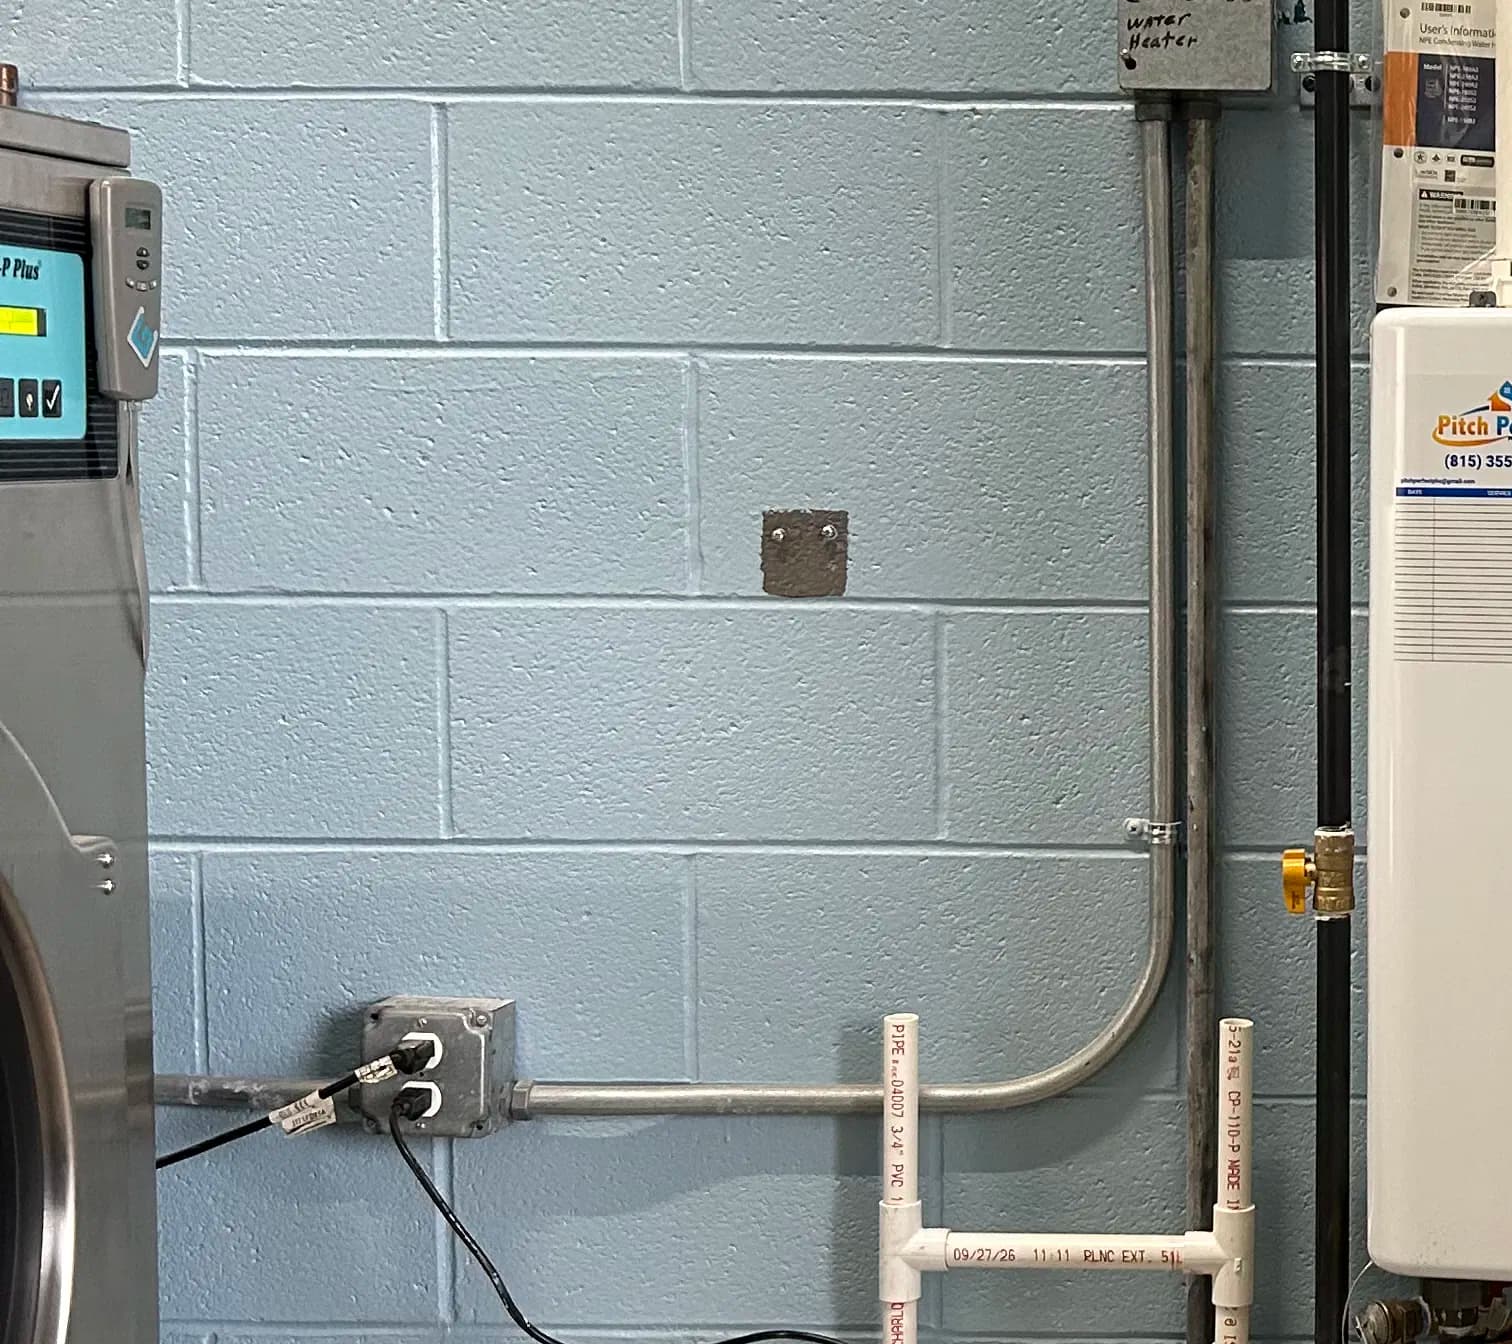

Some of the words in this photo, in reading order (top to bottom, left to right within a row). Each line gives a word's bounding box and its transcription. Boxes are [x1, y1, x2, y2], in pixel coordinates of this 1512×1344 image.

[1420, 22, 1448, 35] User's
[1438, 415, 1489, 436] Pitch
[1444, 454, 1482, 471] (815)
[892, 1024, 904, 1056] PIPE
[1227, 1091, 1241, 1153] CP-110-P
[891, 1163, 903, 1188] PVC
[1226, 1159, 1241, 1191] MADE
[953, 1248, 1016, 1262] 09/27/26
